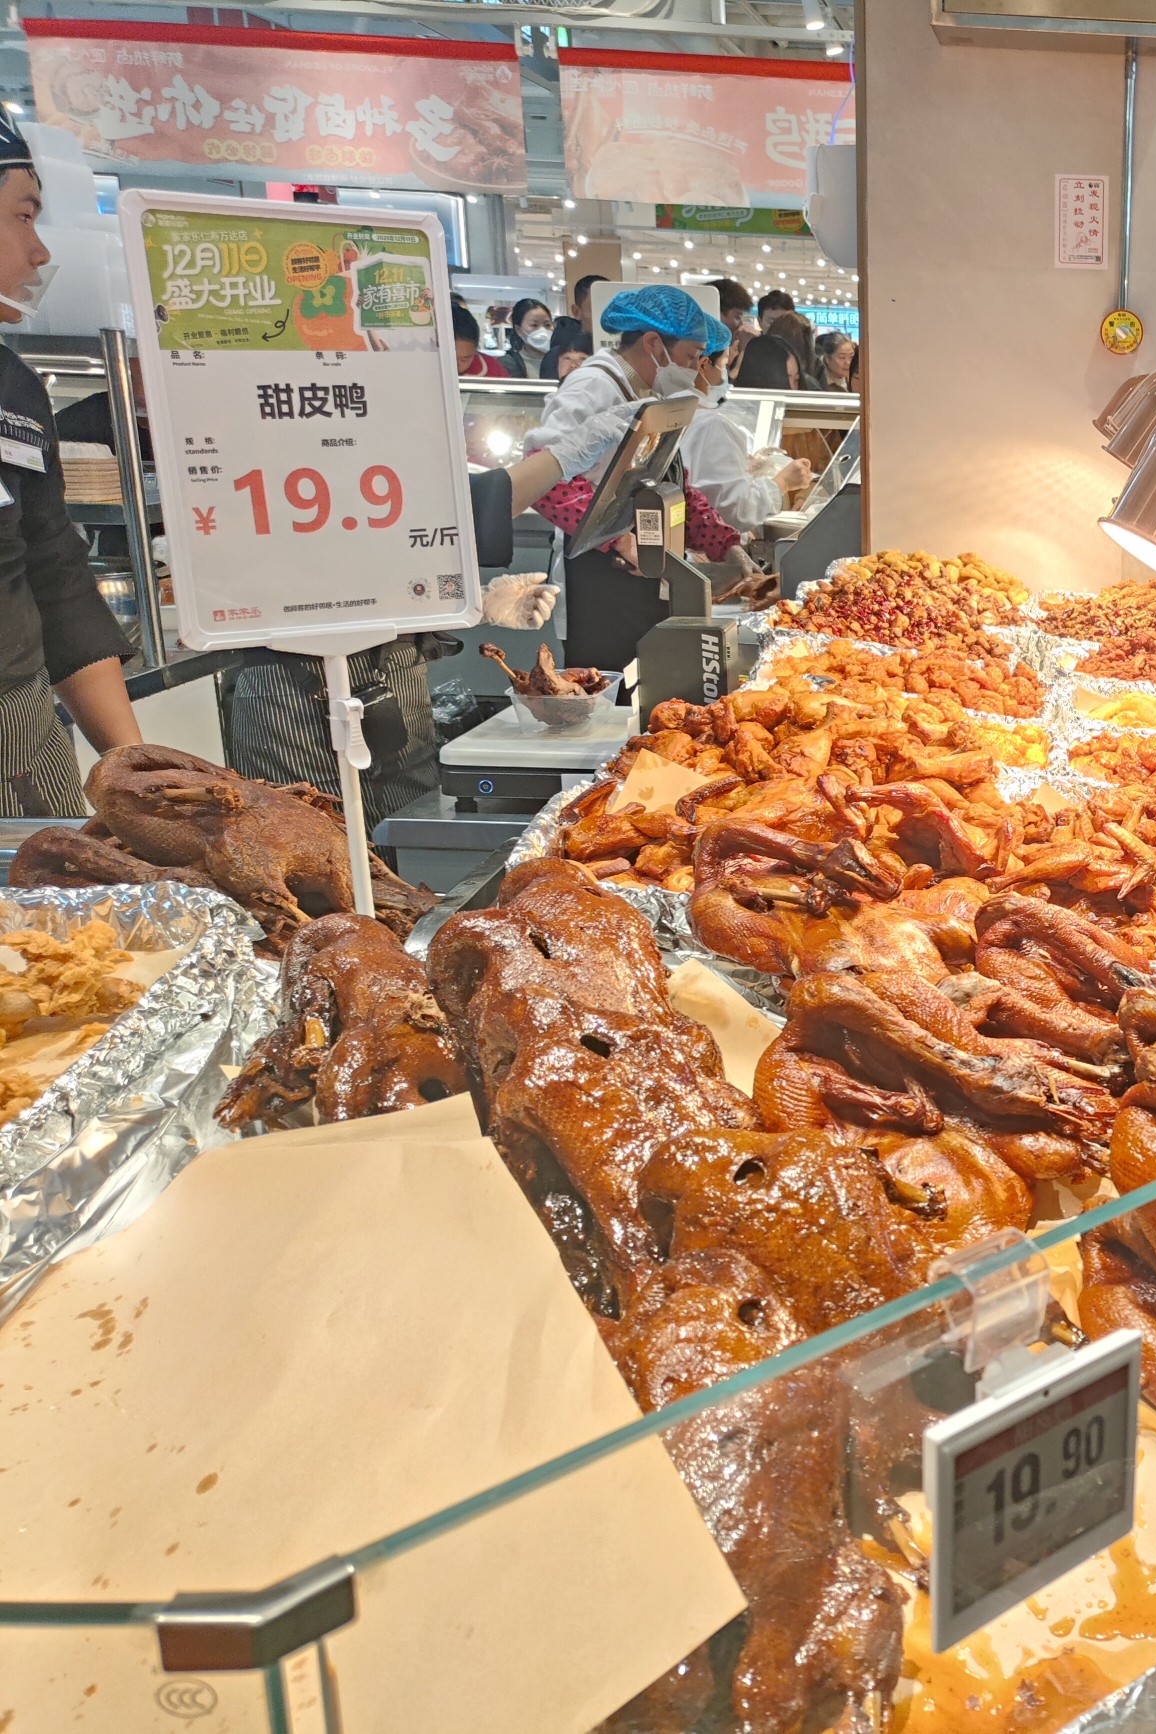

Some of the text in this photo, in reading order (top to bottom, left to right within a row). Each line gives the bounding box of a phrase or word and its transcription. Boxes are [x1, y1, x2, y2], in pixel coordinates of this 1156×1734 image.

[162, 242, 268, 279] 12月11日
[161, 275, 283, 310] 盛大开业
[286, 274, 323, 285] OPENING
[256, 382, 369, 420] 甜皮鸭
[234, 464, 404, 536] 19.9
[409, 527, 460, 548] 元/斤
